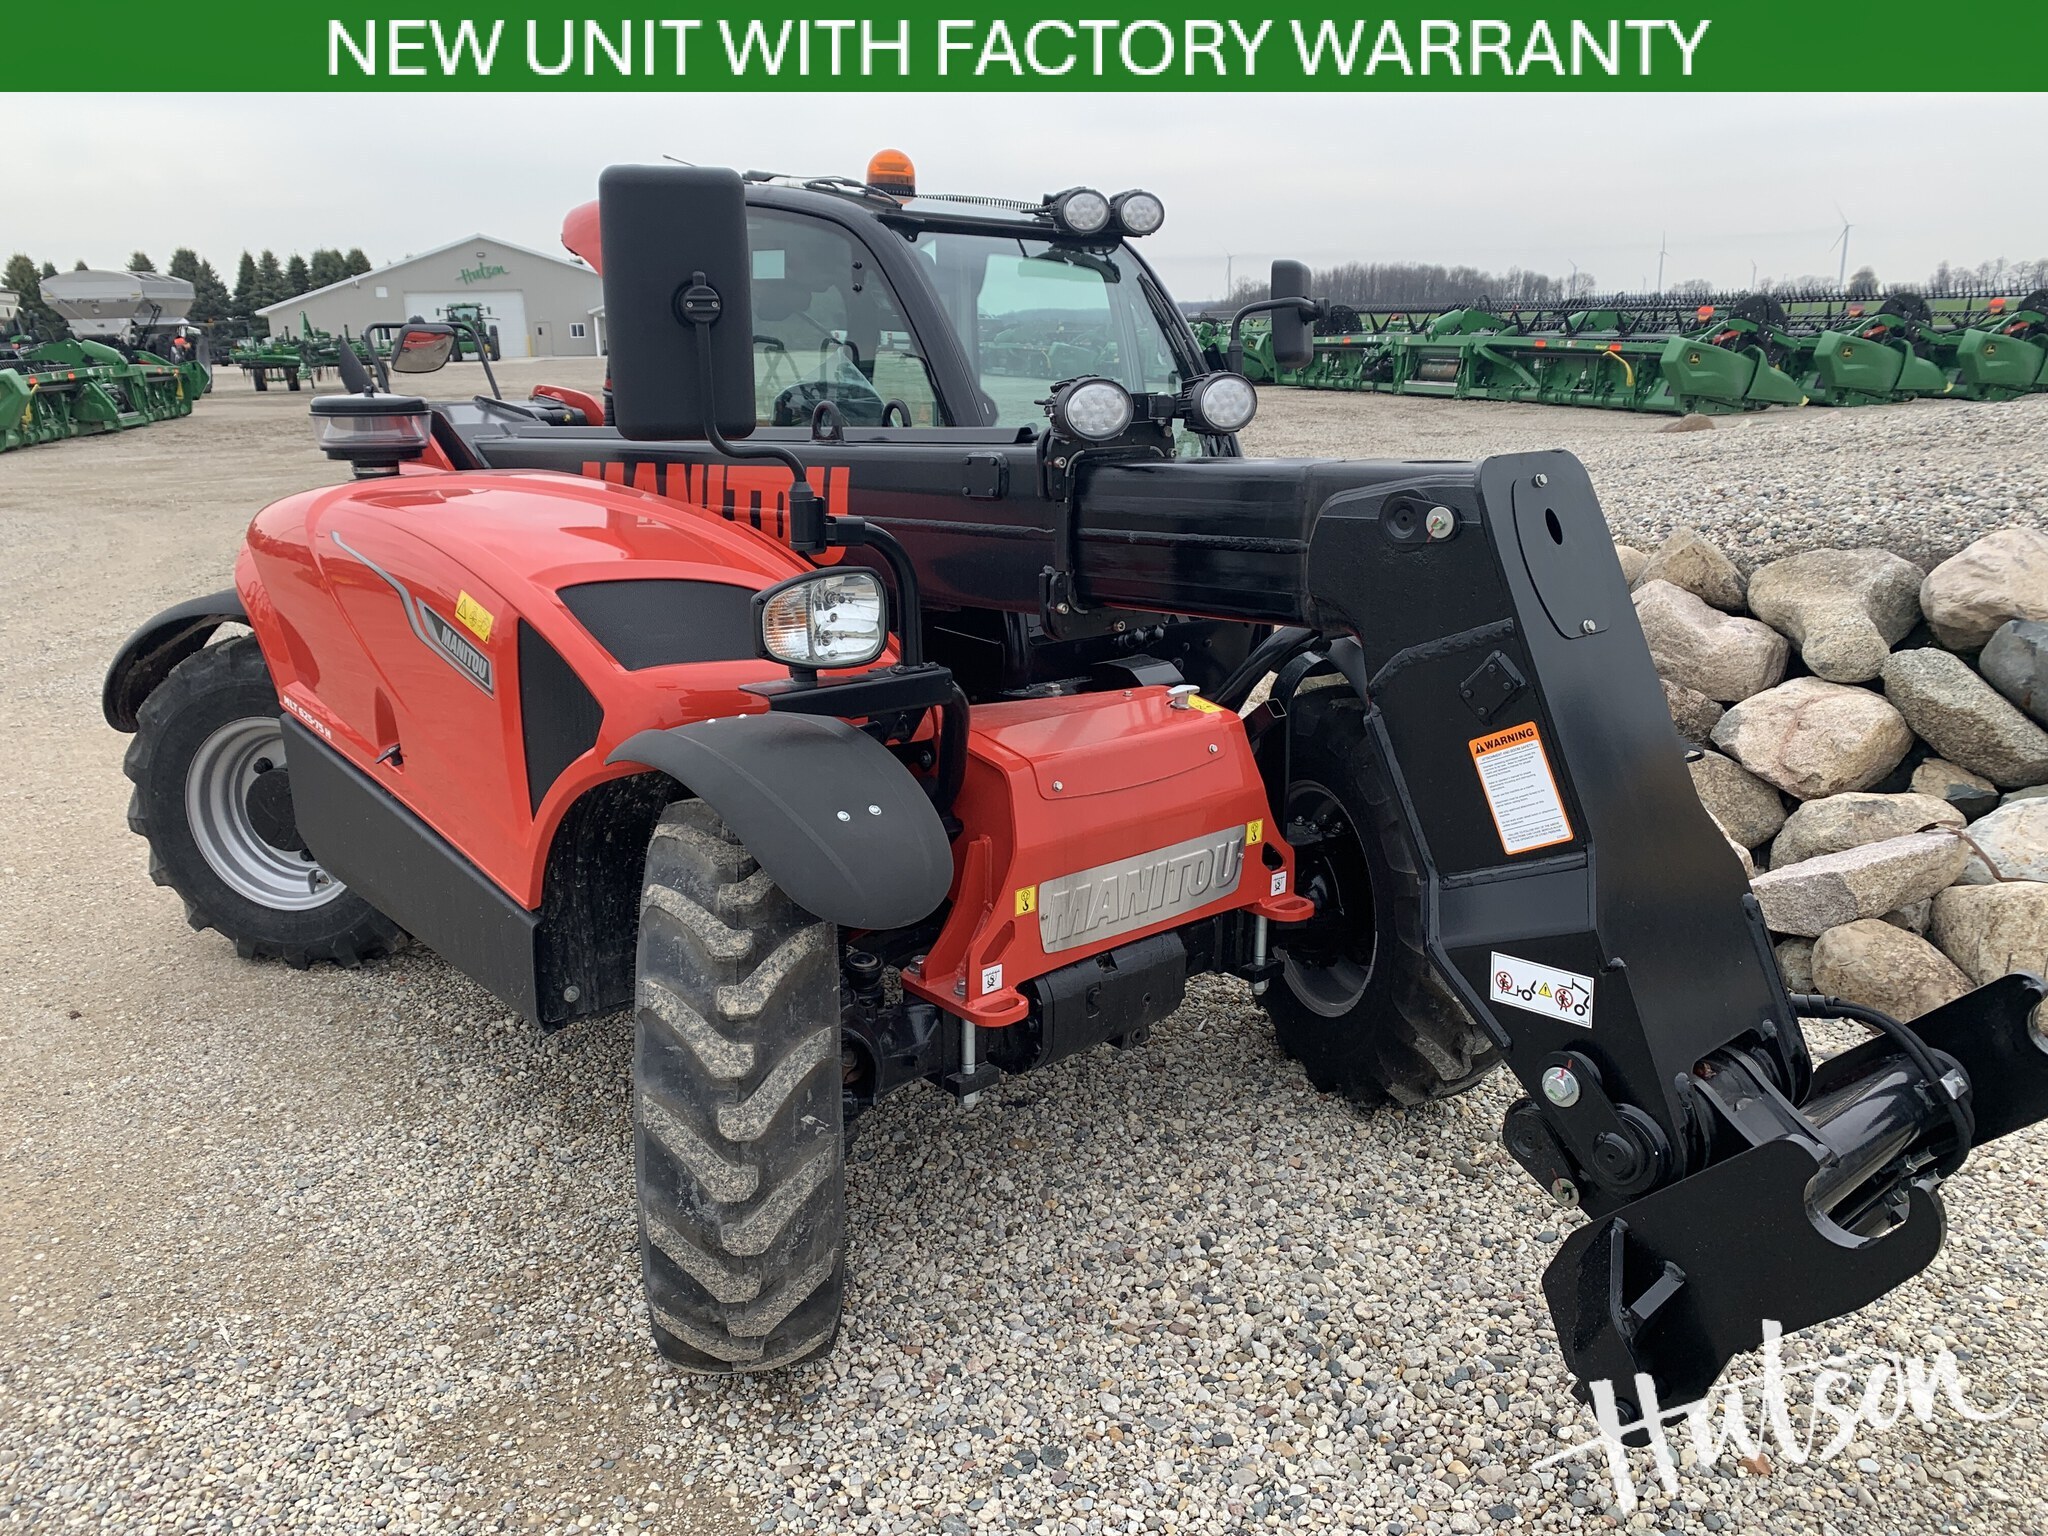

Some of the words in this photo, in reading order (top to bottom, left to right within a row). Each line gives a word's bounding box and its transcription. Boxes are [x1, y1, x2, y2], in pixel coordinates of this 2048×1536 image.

[454, 262, 511, 285] Hutson
[441, 625, 489, 680] MANITOU
[283, 695, 298, 712] MLT
[324, 727, 332, 739] H
[1484, 727, 1534, 750] WARNING
[1047, 836, 1243, 944] MANITOU
